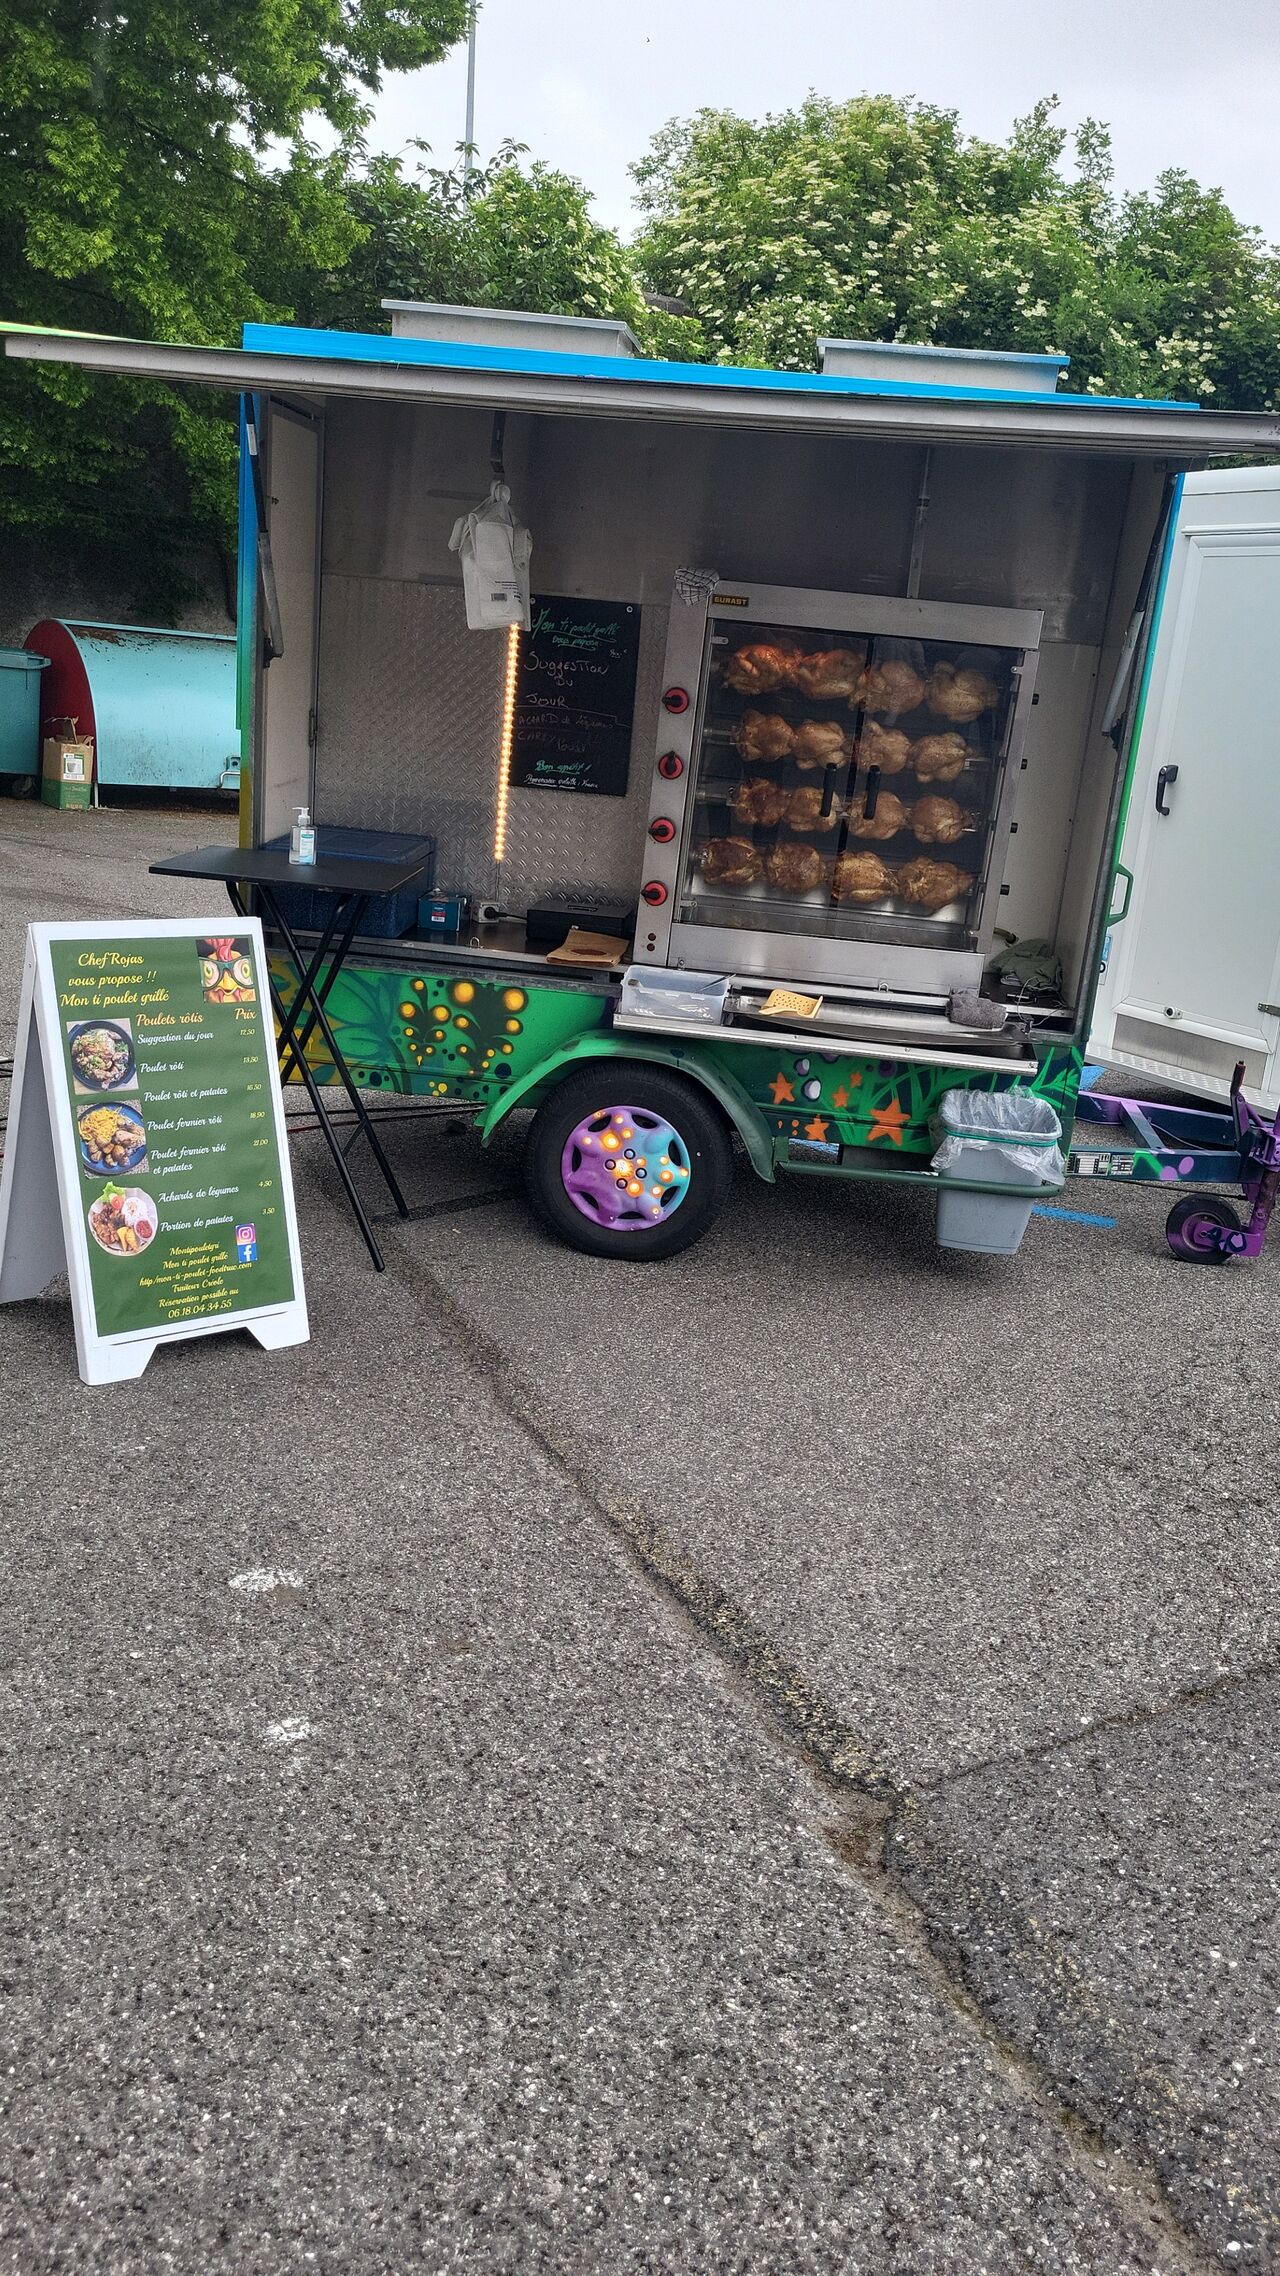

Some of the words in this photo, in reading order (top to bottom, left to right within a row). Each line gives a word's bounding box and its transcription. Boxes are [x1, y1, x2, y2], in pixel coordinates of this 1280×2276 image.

[78, 952, 107, 968] Chef
[110, 952, 145, 967] Rojas
[68, 976, 96, 987] vous
[98, 973, 143, 988] propose
[146, 970, 157, 983] !!
[60, 993, 88, 1007] Mon
[92, 993, 102, 1006] ti
[103, 991, 138, 1008] poulet
[140, 989, 169, 1006] grillé
[136, 1012, 176, 1027] Poulets
[179, 1012, 203, 1024] rôtis
[234, 1007, 257, 1021] Prix
[137, 1032, 181, 1046] Suggestion
[183, 1032, 196, 1041] du
[196, 1031, 214, 1045] jour
[140, 1062, 166, 1074] Poulet
[169, 1061, 184, 1071] rôti
[143, 1091, 171, 1102] Poulet
[173, 1089, 188, 1100] rôti
[190, 1089, 198, 1098] et
[199, 1087, 228, 1098] patates
[147, 1119, 174, 1131] Poulet
[175, 1117, 206, 1131] fermier
[208, 1115, 223, 1124] rôti
[150, 1149, 177, 1160] Poulet
[178, 1146, 210, 1160] fermier
[211, 1143, 227, 1153] rôti
[153, 1166, 161, 1175] et
[162, 1163, 193, 1176] patates
[157, 1191, 194, 1204] Achards
[195, 1188, 207, 1198] de
[208, 1185, 240, 1198] légumes
[160, 1220, 191, 1232] Portion
[193, 1217, 204, 1227] de
[205, 1215, 234, 1227] patates
[163, 1261, 180, 1270] Mon
[188, 1255, 210, 1268] poulet
